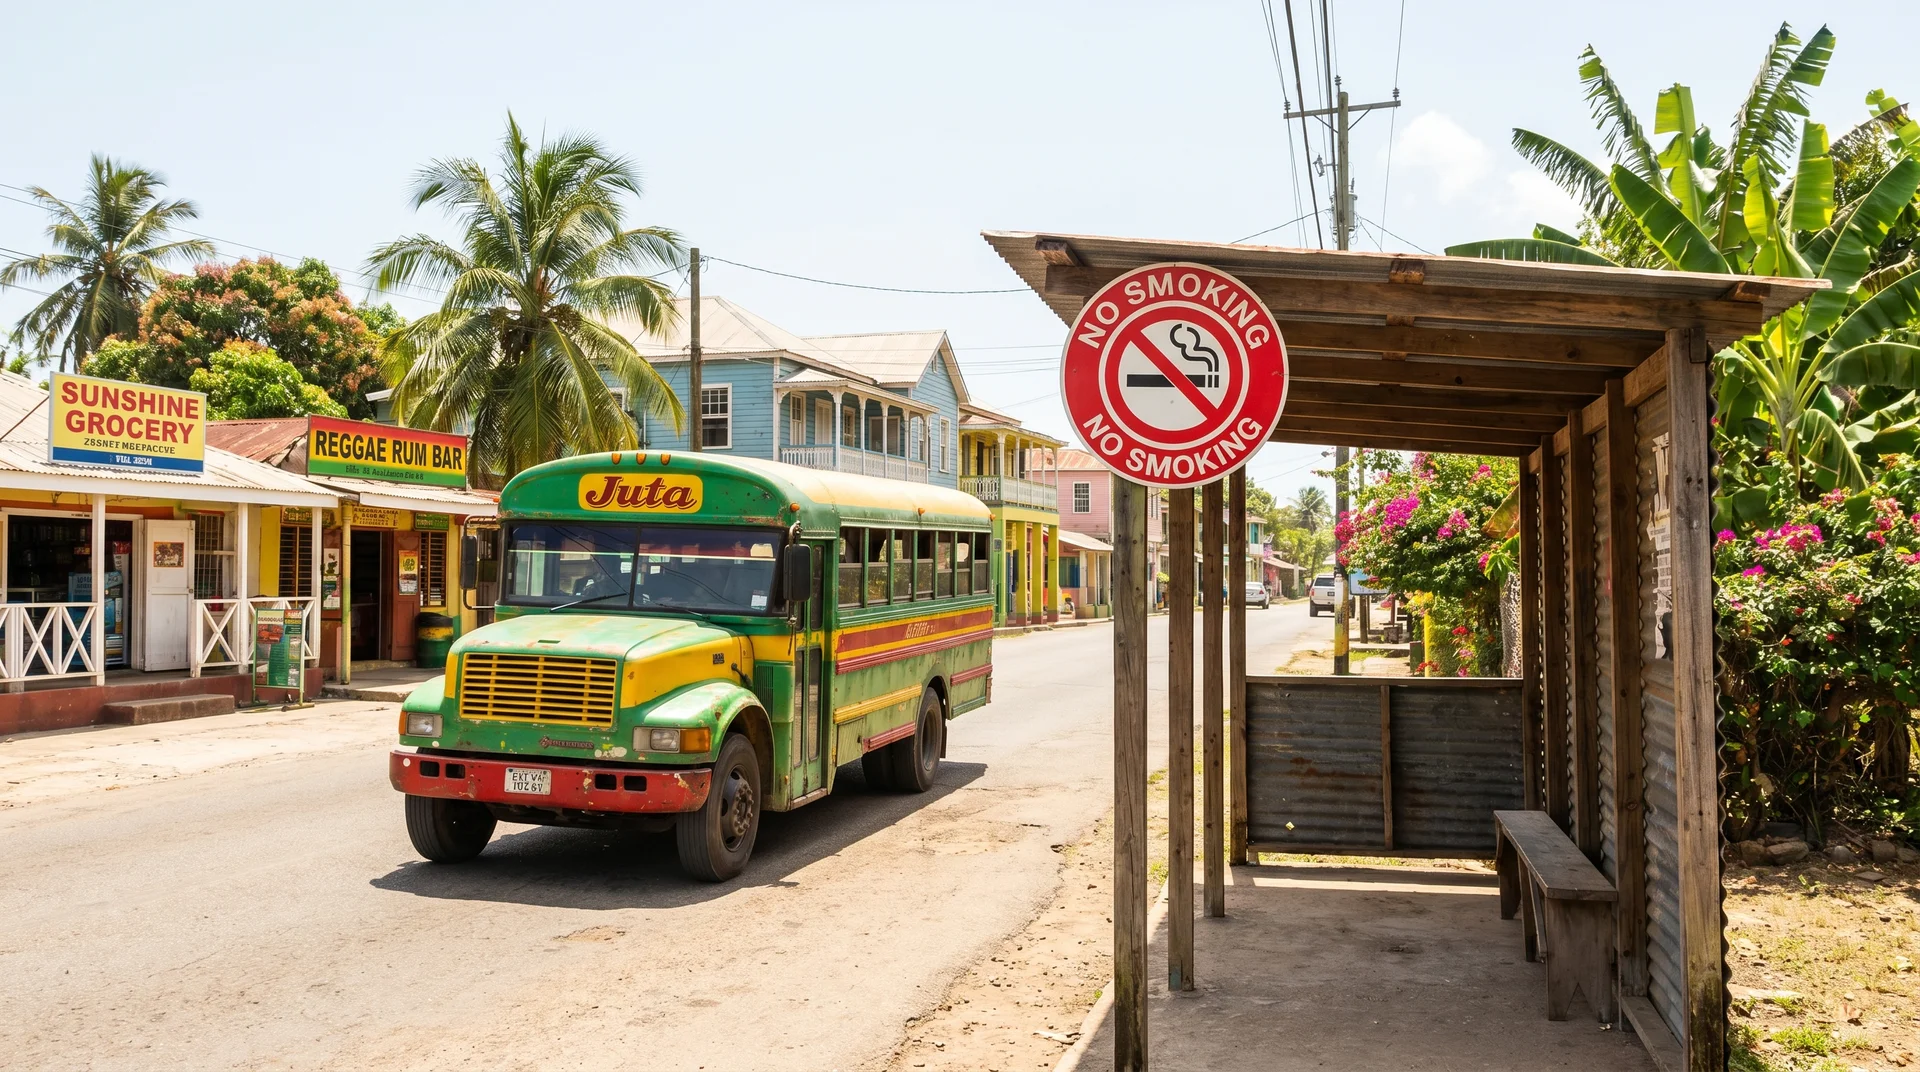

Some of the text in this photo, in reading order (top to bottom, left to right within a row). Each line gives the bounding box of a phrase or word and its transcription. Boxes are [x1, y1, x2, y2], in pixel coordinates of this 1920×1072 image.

[1077, 272, 1270, 350] NO SMOKING
[61, 381, 199, 420] SUNSHINE
[65, 409, 195, 444] GROCERY
[1082, 413, 1263, 479] NO SMOKING
[315, 430, 463, 470] REGGAE RUM BAR
[585, 476, 697, 510] Juta
